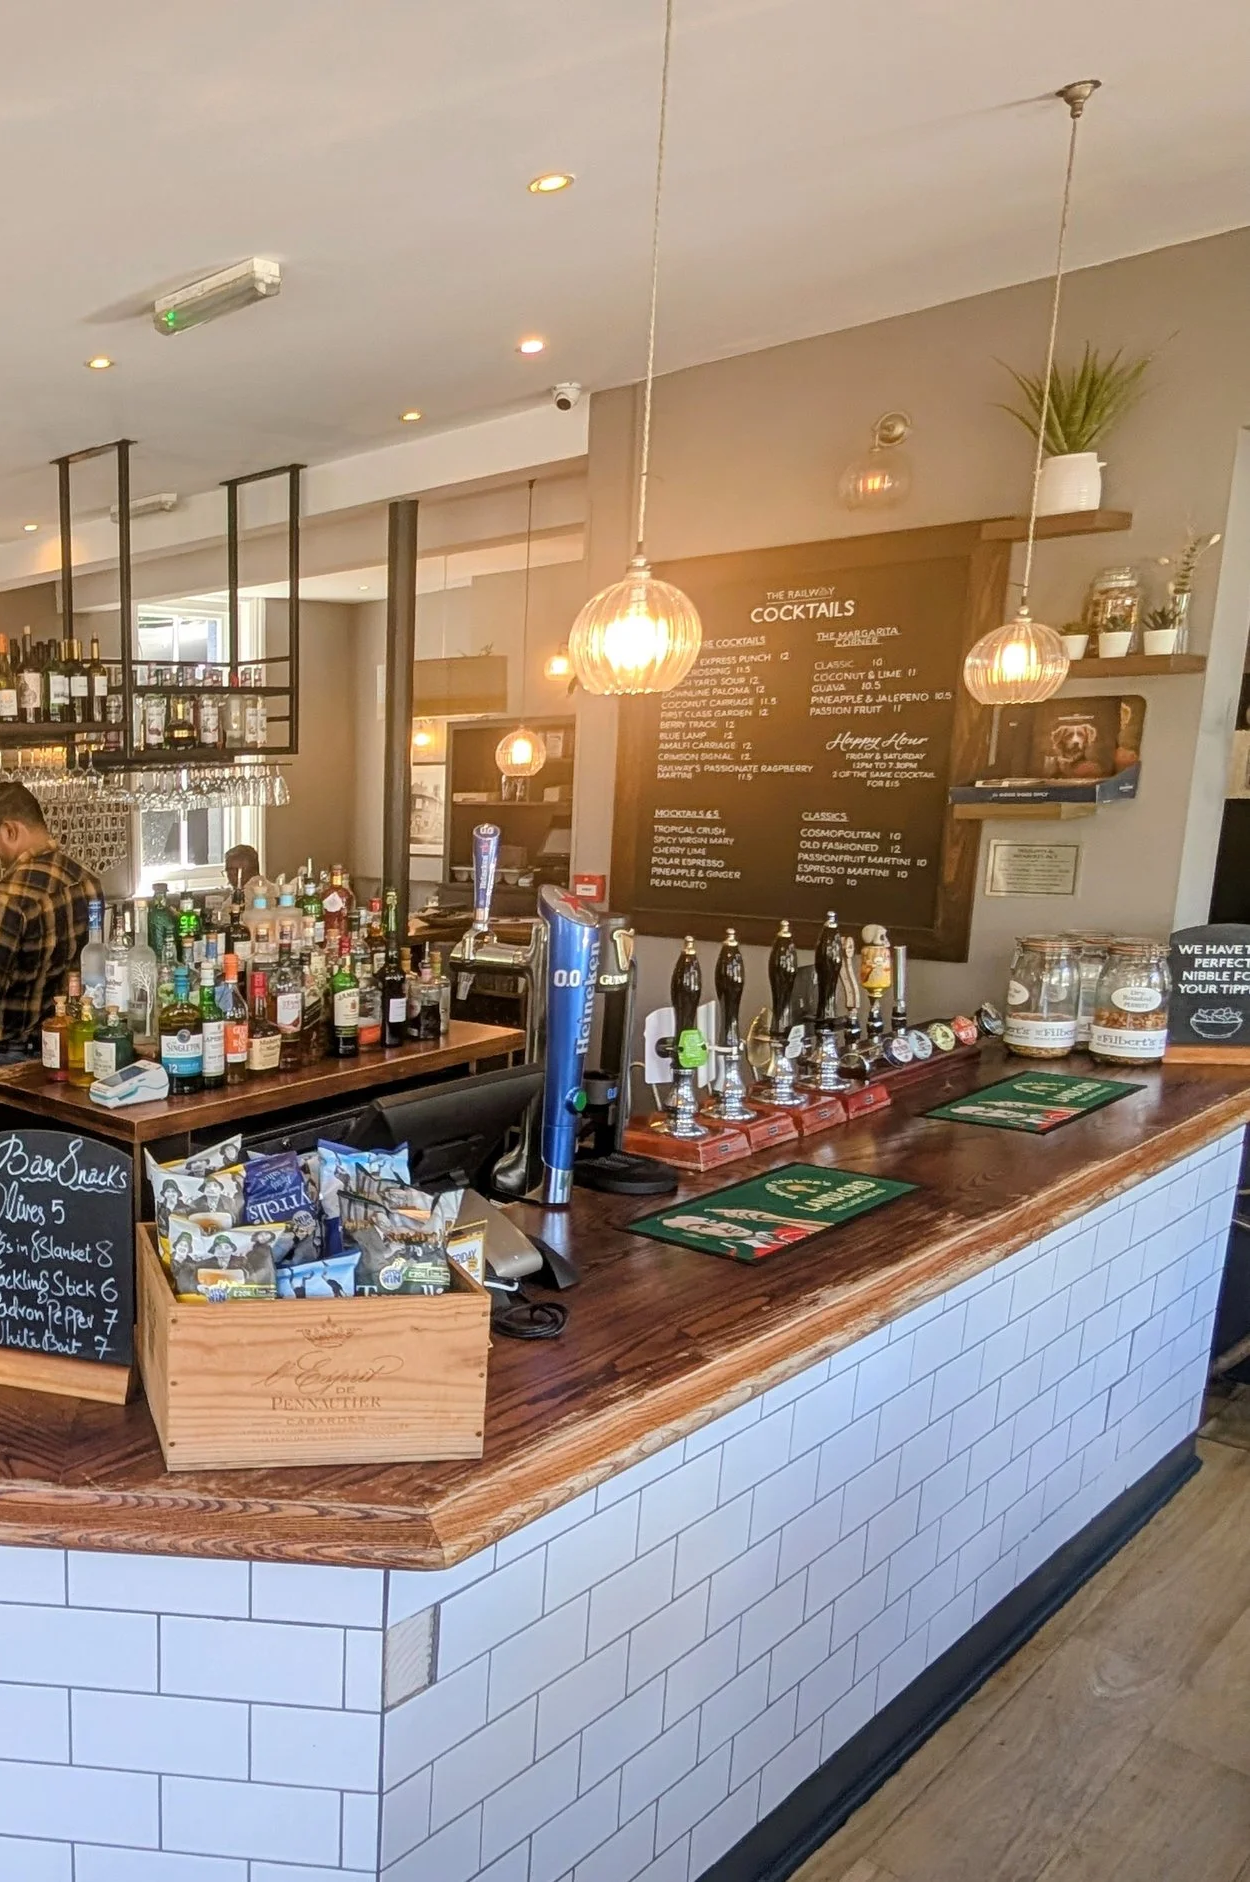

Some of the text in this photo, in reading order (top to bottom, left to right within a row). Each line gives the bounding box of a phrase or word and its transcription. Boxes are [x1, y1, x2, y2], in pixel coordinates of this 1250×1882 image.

[766, 587, 835, 600] THE RAILWAY
[750, 600, 855, 622] COCKTAILS
[816, 627, 899, 641] THE MARGARITA
[716, 636, 766, 648] COCKTAILS
[835, 638, 879, 646] CORNER
[700, 652, 790, 666] EXPRESS PUNCH 12
[814, 658, 883, 670] CLASSIC 10
[720, 677, 745, 685] SOUR
[813, 670, 902, 682] COCONUT LIME
[712, 687, 750, 696] PALOMA
[756, 686, 765, 694] 12
[812, 681, 881, 693] GUAVA 10.5
[661, 697, 777, 709] COCONUT CARRIAGE 11.5
[811, 694, 863, 704] PINEAPPLE
[935, 692, 952, 700] 10.5
[660, 708, 769, 719] FIRST CLASS GARDEN 12
[810, 705, 883, 716] PASSION FRUIT
[660, 720, 735, 729] BERRY TRACK 12
[659, 731, 734, 740] BLUE LAMP 12
[825, 731, 929, 751] Happy Hour
[659, 741, 752, 750] AMALFI CARRIAGE 12
[658, 752, 751, 761] CRIMSON SIGNAL 12
[845, 752, 926, 760] FRIDAY SATURDAY
[703, 764, 759, 773] PASSIONATE
[874, 761, 886, 769] TO
[656, 772, 753, 781] MARTINI 11.5
[894, 771, 937, 779] COCKTAIL
[866, 780, 884, 788] FOR
[654, 809, 704, 818] MOCKTAILS
[801, 811, 848, 821] CLASSICS
[653, 825, 726, 836] TROPICAL CRUSH
[800, 828, 902, 840] COSMOPOLITAN 10
[653, 835, 735, 846] SPICY VIRGIN MARY
[652, 846, 707, 855] CHERRY LIME
[799, 840, 901, 854] OLD FASHIONED 12
[651, 856, 725, 868] POLAR ESPRESSO
[867, 855, 911, 866] MARTINI
[916, 859, 928, 867] 10
[651, 866, 741, 880] PINEAPPLE GINGER
[797, 863, 908, 879] ESPRESSO MARTINI 10
[650, 878, 707, 890] PEAR MOJITO
[795, 875, 857, 886] MOJITO 10
[1178, 944, 1204, 955] WE
[1205, 944, 1244, 955] HAVE
[1194, 957, 1250, 968] PERFECT
[553, 969, 582, 988] 0.0
[1182, 970, 1231, 981] NIBBLE
[1177, 983, 1250, 995] YOUR TIPP
[575, 942, 600, 1055] Heineken
[169, 1063, 179, 1074] 12
[56, 1138, 127, 1189] Snacks
[249, 1183, 316, 1224] yrrells
[51, 1200, 66, 1224] 5
[16, 1239, 29, 1255] in
[30, 1230, 92, 1263] Blanket
[95, 1240, 114, 1268] 8
[51, 1270, 97, 1298] Stick
[100, 1277, 119, 1302] 6
[47, 1299, 95, 1336] Pepper
[102, 1308, 119, 1336] 7
[94, 1335, 116, 1360] 7
[336, 1386, 356, 1395] DE
[271, 1396, 381, 1411] PENNAUTIER
